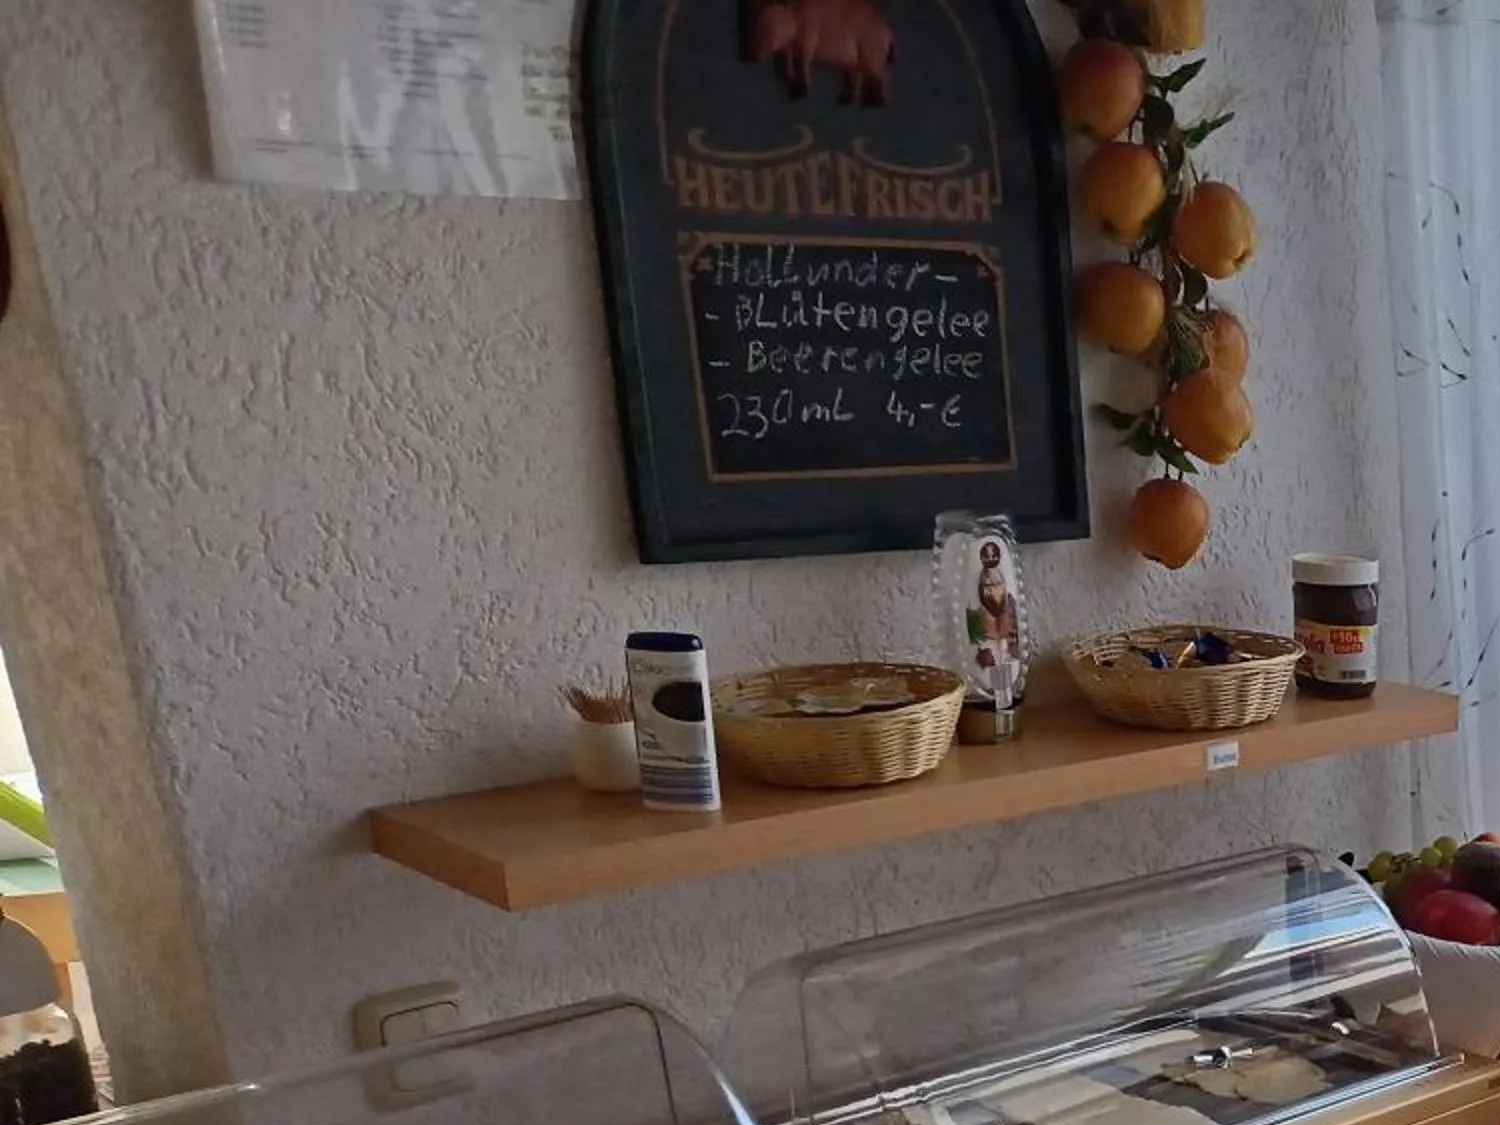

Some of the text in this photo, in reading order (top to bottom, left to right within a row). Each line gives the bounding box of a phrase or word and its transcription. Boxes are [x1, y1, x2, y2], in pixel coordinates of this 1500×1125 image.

[675, 150, 992, 222] HEUTE FRISCH
[747, 340, 984, 381] Beerengelee
